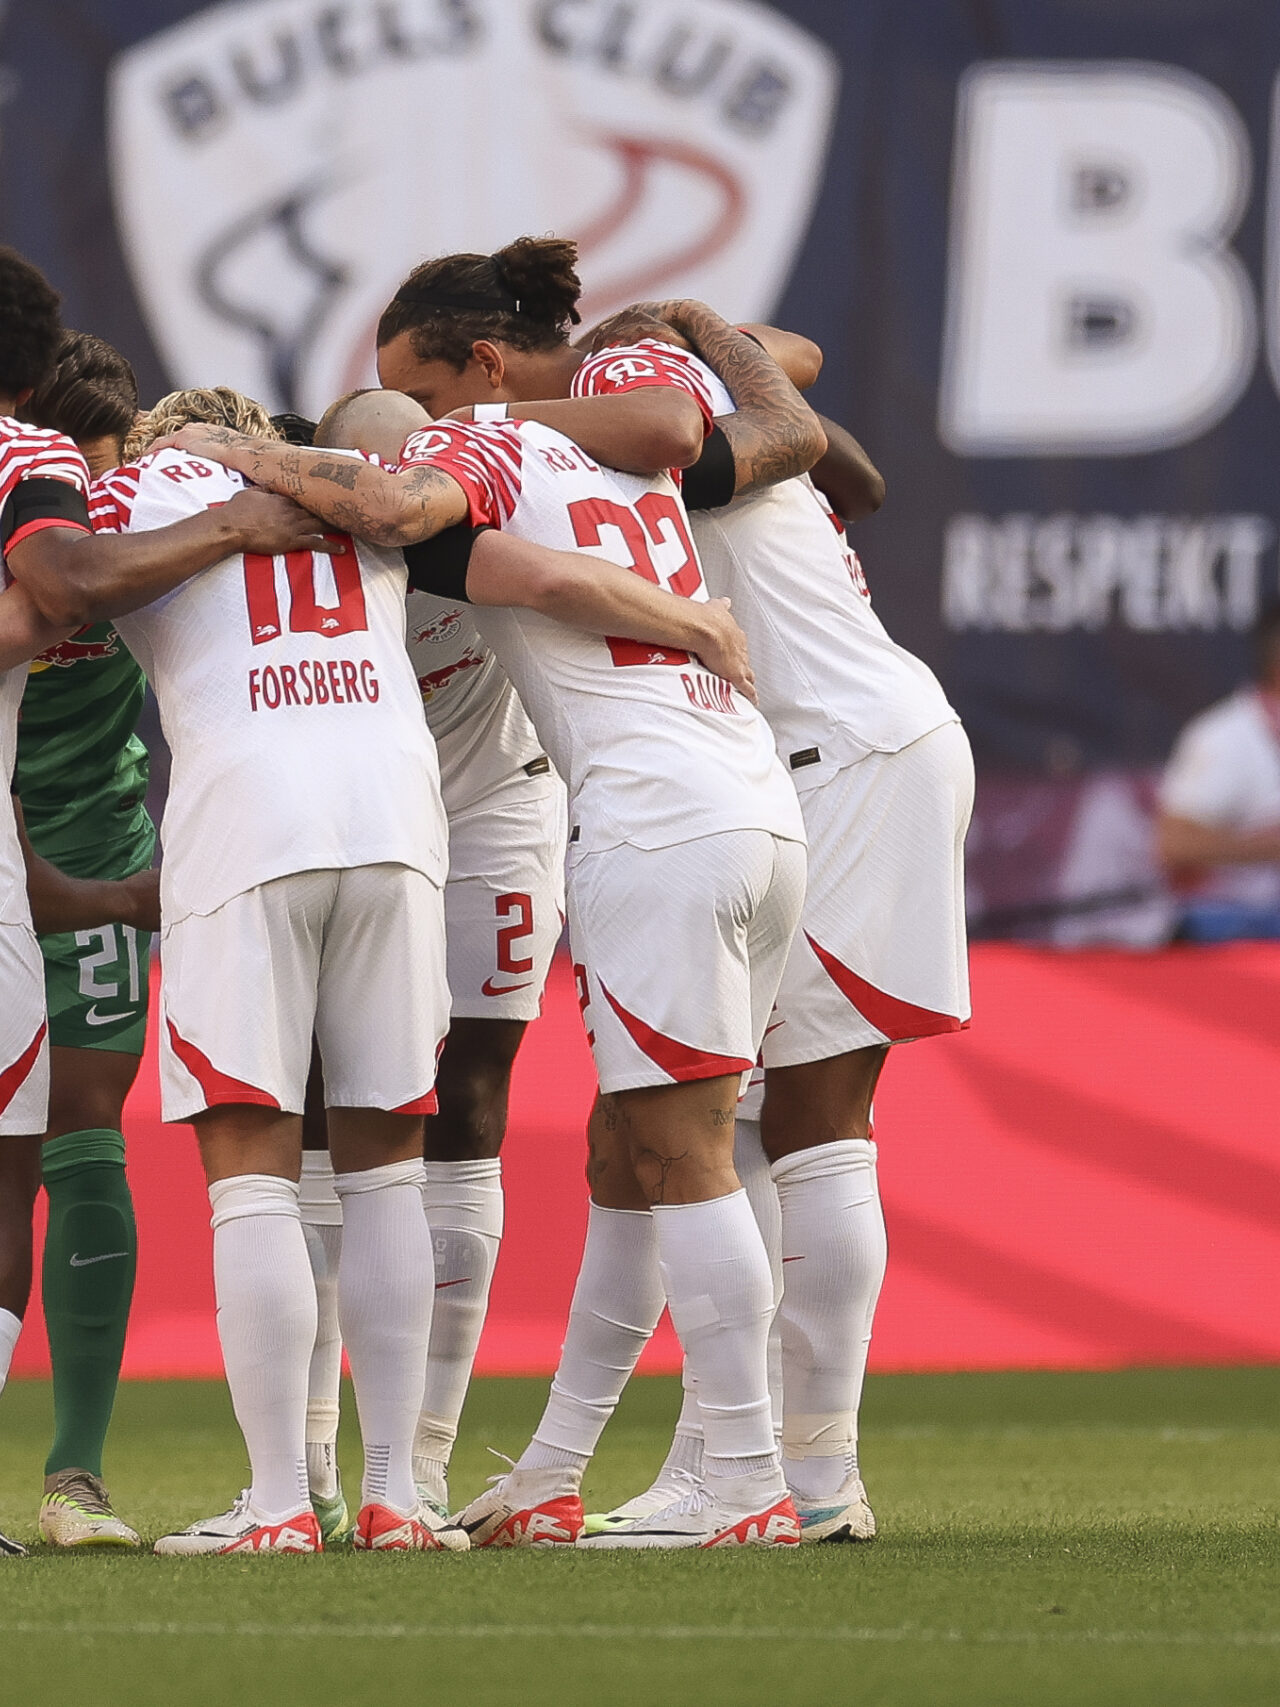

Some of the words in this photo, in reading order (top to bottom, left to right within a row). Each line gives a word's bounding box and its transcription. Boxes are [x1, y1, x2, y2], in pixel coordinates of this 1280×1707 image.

[528, 0, 798, 142] CLUB
[938, 55, 1280, 458] B
[159, 460, 213, 483] RB
[538, 445, 577, 472] RB
[206, 500, 369, 646] 10
[567, 491, 704, 667] 22
[942, 515, 1270, 632] RESPEKT
[248, 659, 380, 712] FORSBERG
[74, 923, 140, 1002] 21
[494, 891, 534, 975] 2
